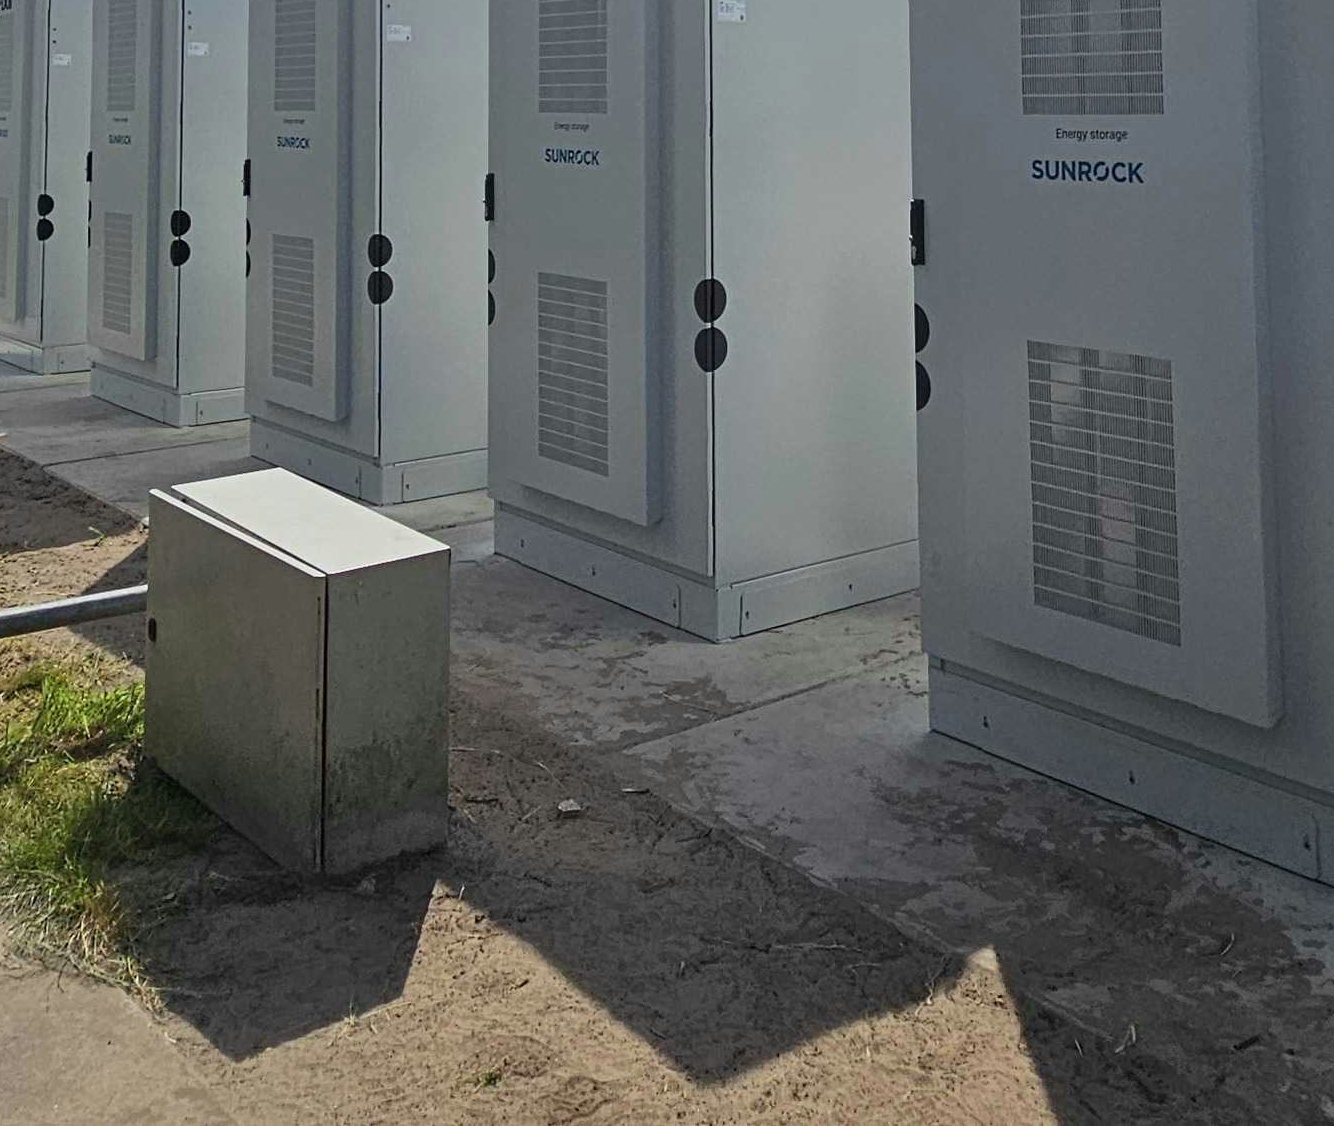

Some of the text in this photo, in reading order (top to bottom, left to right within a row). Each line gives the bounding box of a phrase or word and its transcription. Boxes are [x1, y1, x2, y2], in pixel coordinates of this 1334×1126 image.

[1055, 128, 1129, 142] Energy storage
[545, 148, 600, 165] SUNROCK
[1031, 159, 1145, 183] SUNROCK
